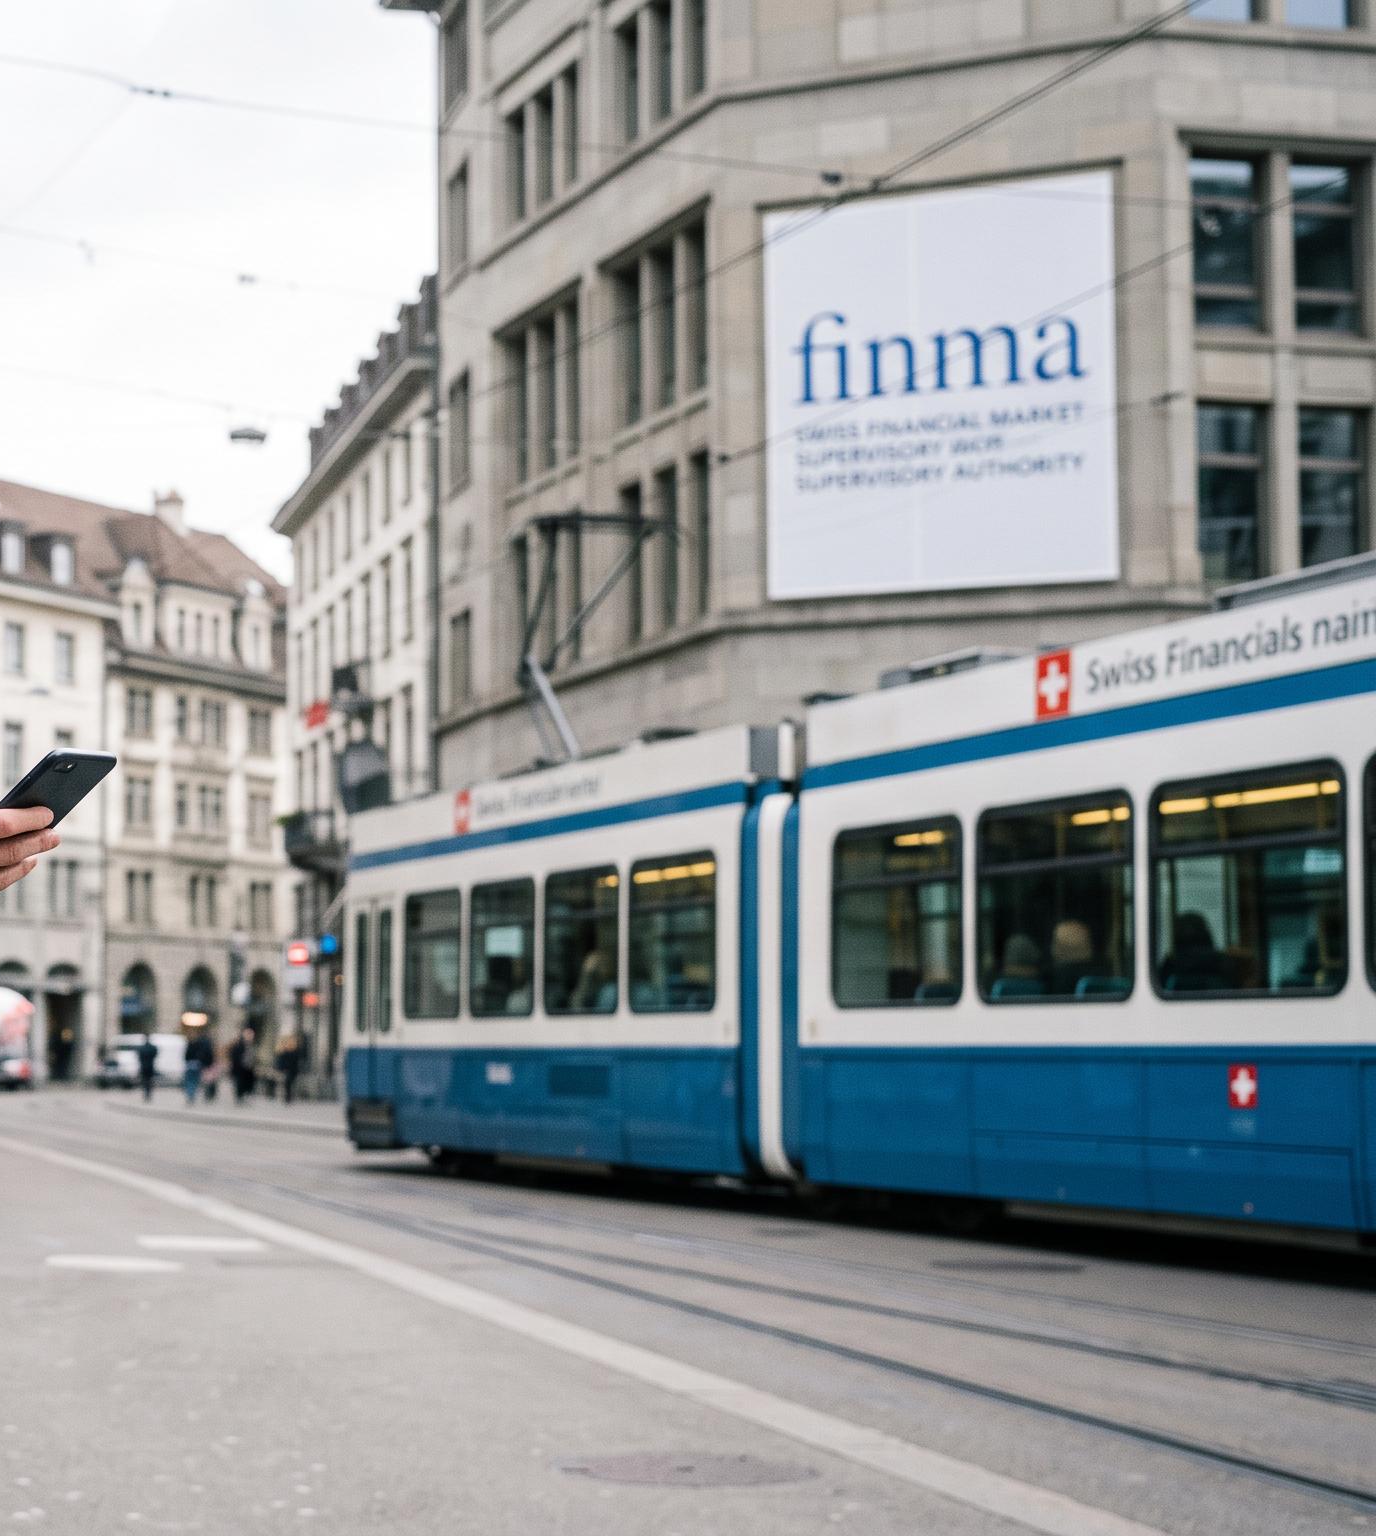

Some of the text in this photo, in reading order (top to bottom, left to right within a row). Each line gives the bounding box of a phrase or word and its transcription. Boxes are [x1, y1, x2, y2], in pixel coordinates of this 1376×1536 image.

[792, 311, 1087, 404] finma
[989, 402, 1083, 426] MARKET
[952, 452, 1084, 481] AUTHORITY
[1086, 650, 1156, 694] Swiss
[1165, 614, 1302, 675] Financials
